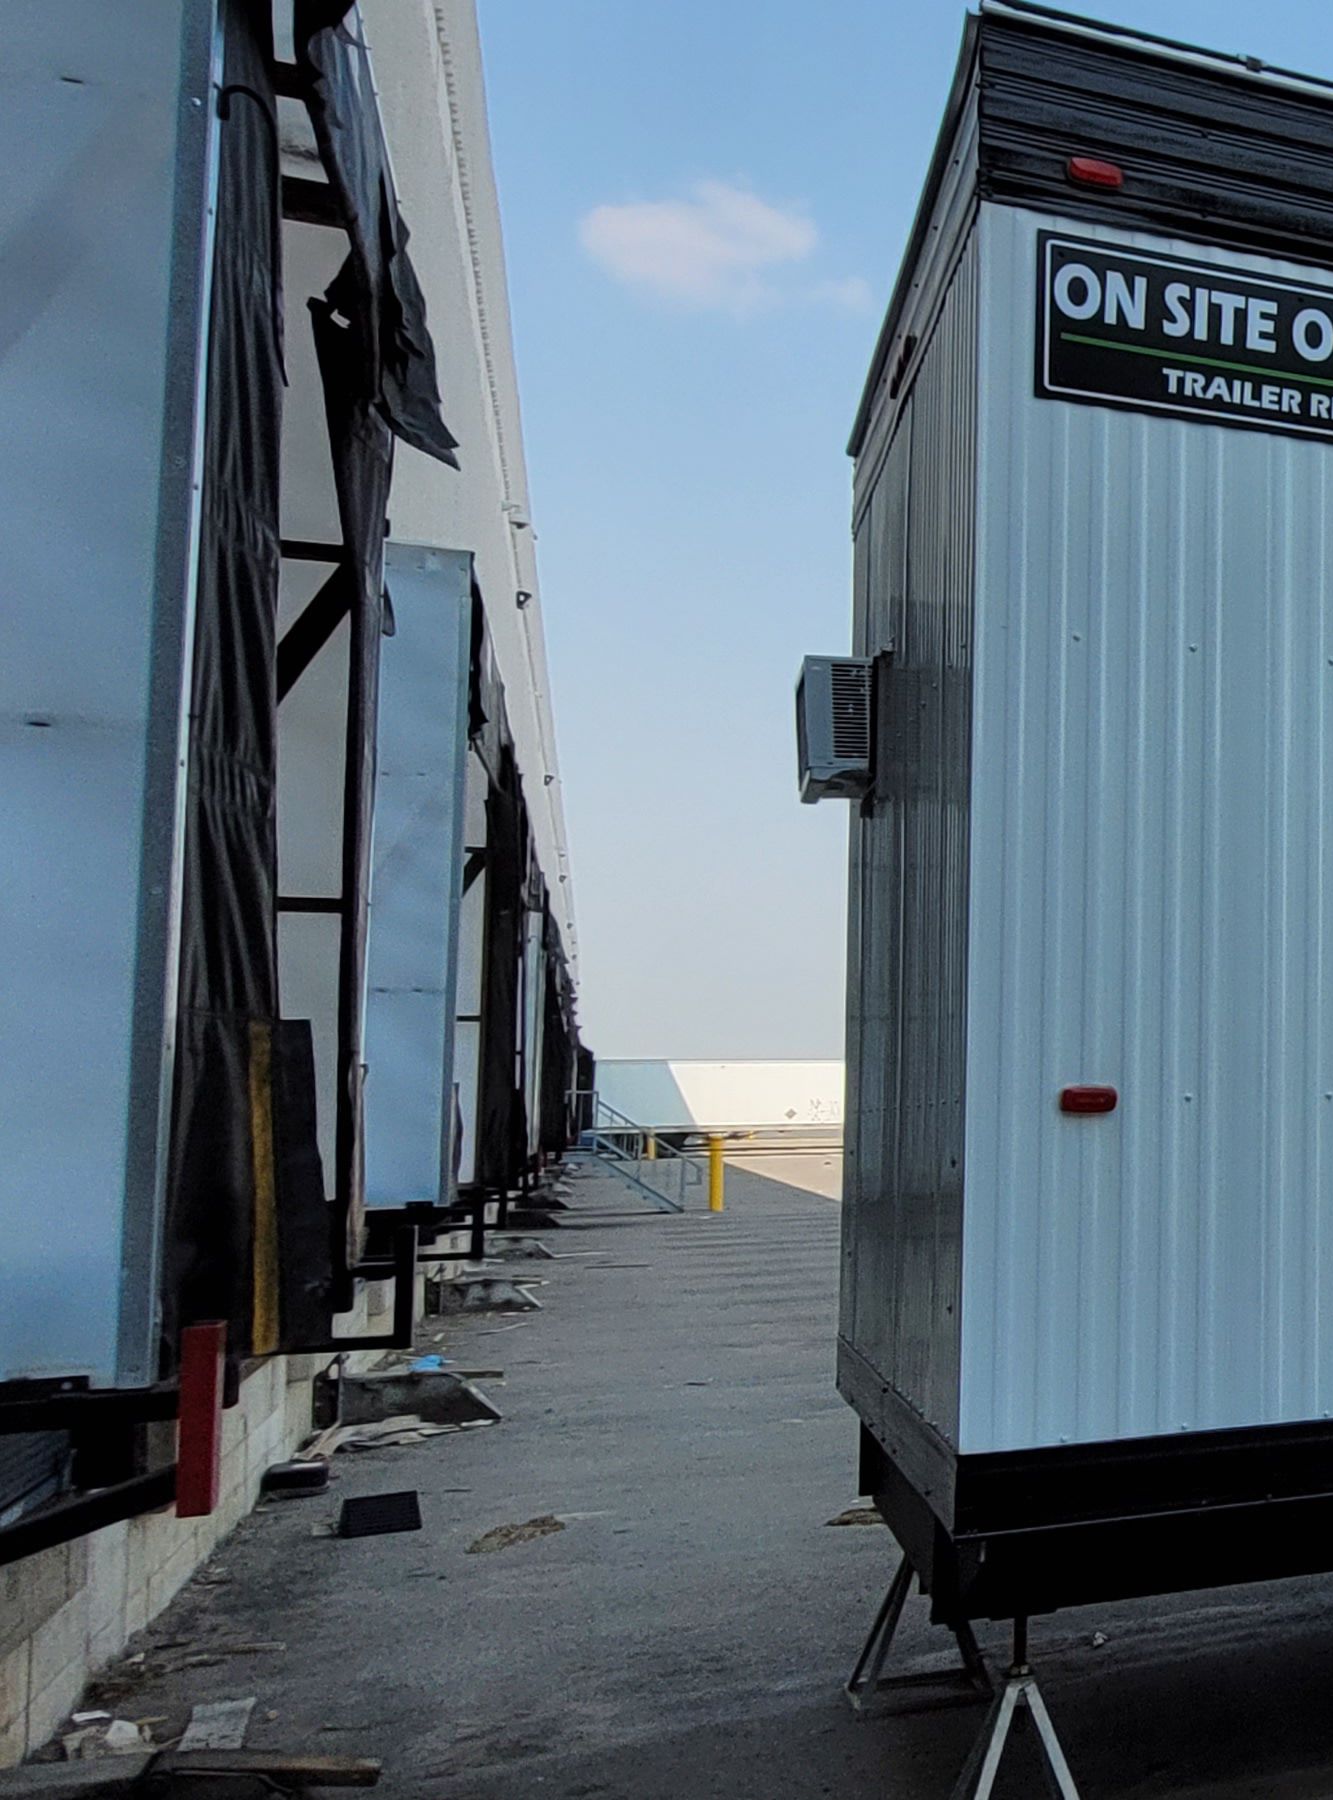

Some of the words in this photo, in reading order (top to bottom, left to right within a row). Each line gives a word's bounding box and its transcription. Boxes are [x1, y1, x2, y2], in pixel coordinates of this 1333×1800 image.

[1053, 262, 1147, 330] ON
[1162, 282, 1278, 353] SITE
[1162, 367, 1302, 414] TRAILER
